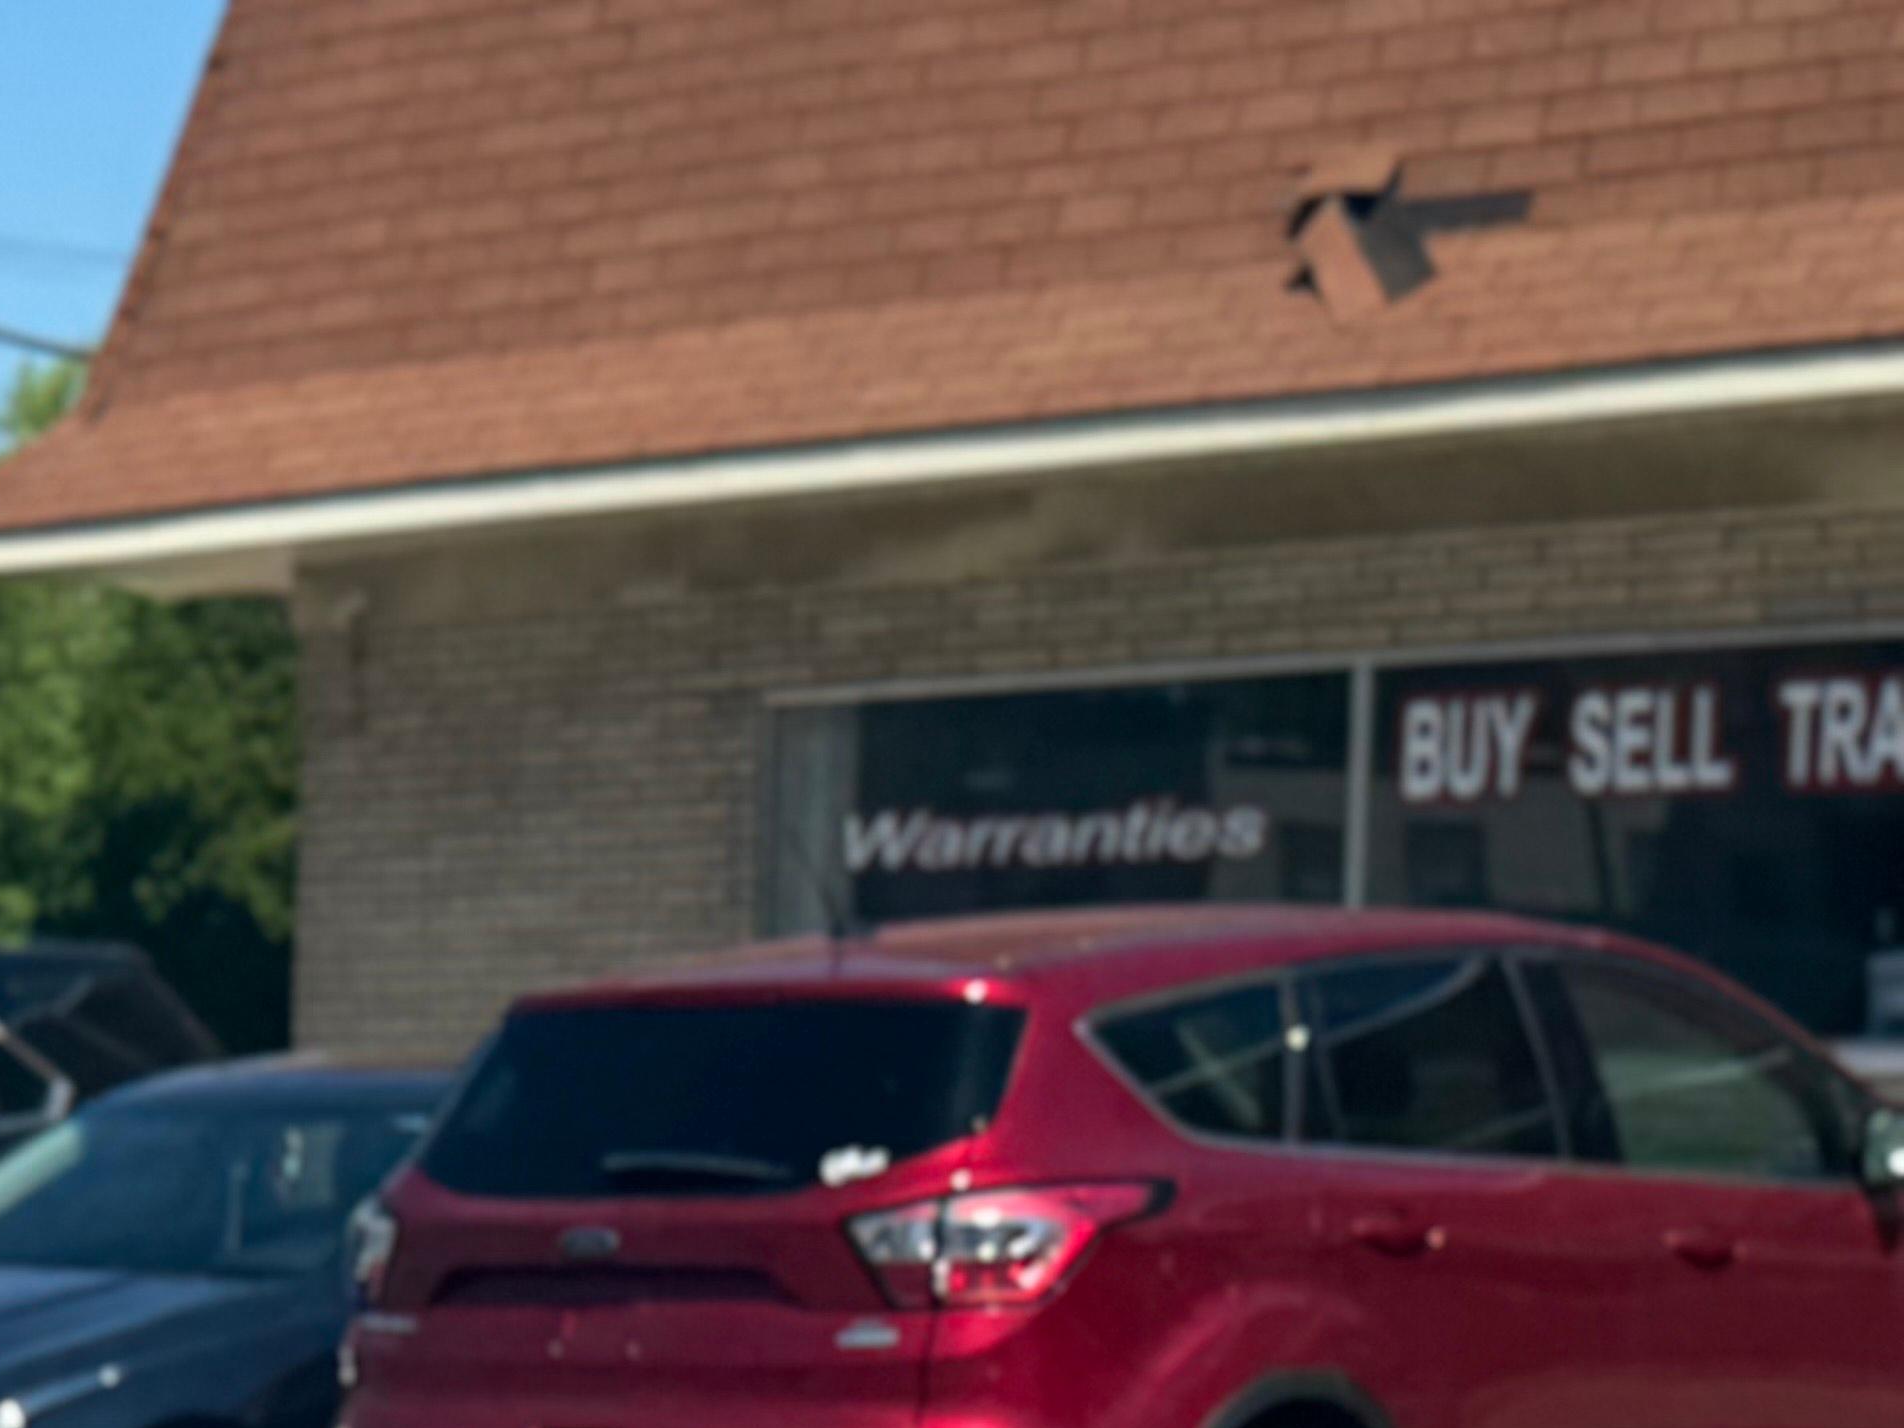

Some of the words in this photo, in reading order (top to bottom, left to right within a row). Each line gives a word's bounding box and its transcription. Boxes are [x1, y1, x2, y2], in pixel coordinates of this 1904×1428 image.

[1400, 694, 1537, 799] BUY
[1567, 685, 1735, 794] SELL
[843, 797, 1267, 873] Warranties
